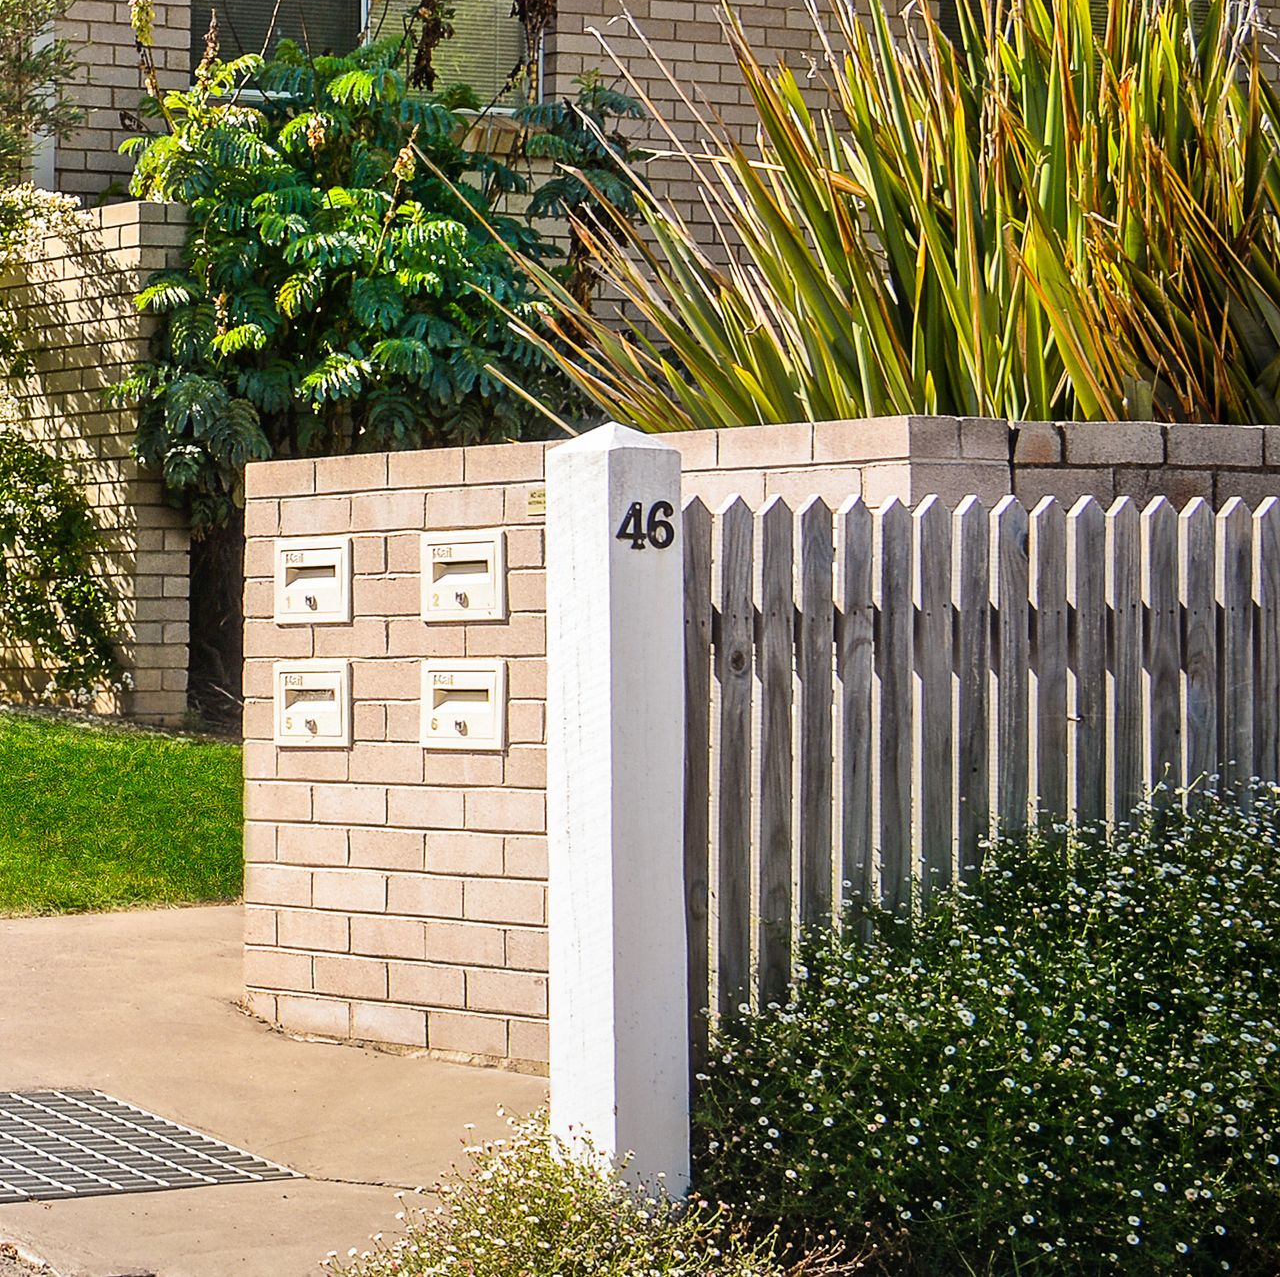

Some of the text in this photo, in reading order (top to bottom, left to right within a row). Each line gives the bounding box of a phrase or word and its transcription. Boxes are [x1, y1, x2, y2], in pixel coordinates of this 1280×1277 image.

[616, 501, 674, 550] 46
[432, 594, 439, 607] 2
[286, 717, 292, 730] 5
[431, 717, 438, 731] 6
